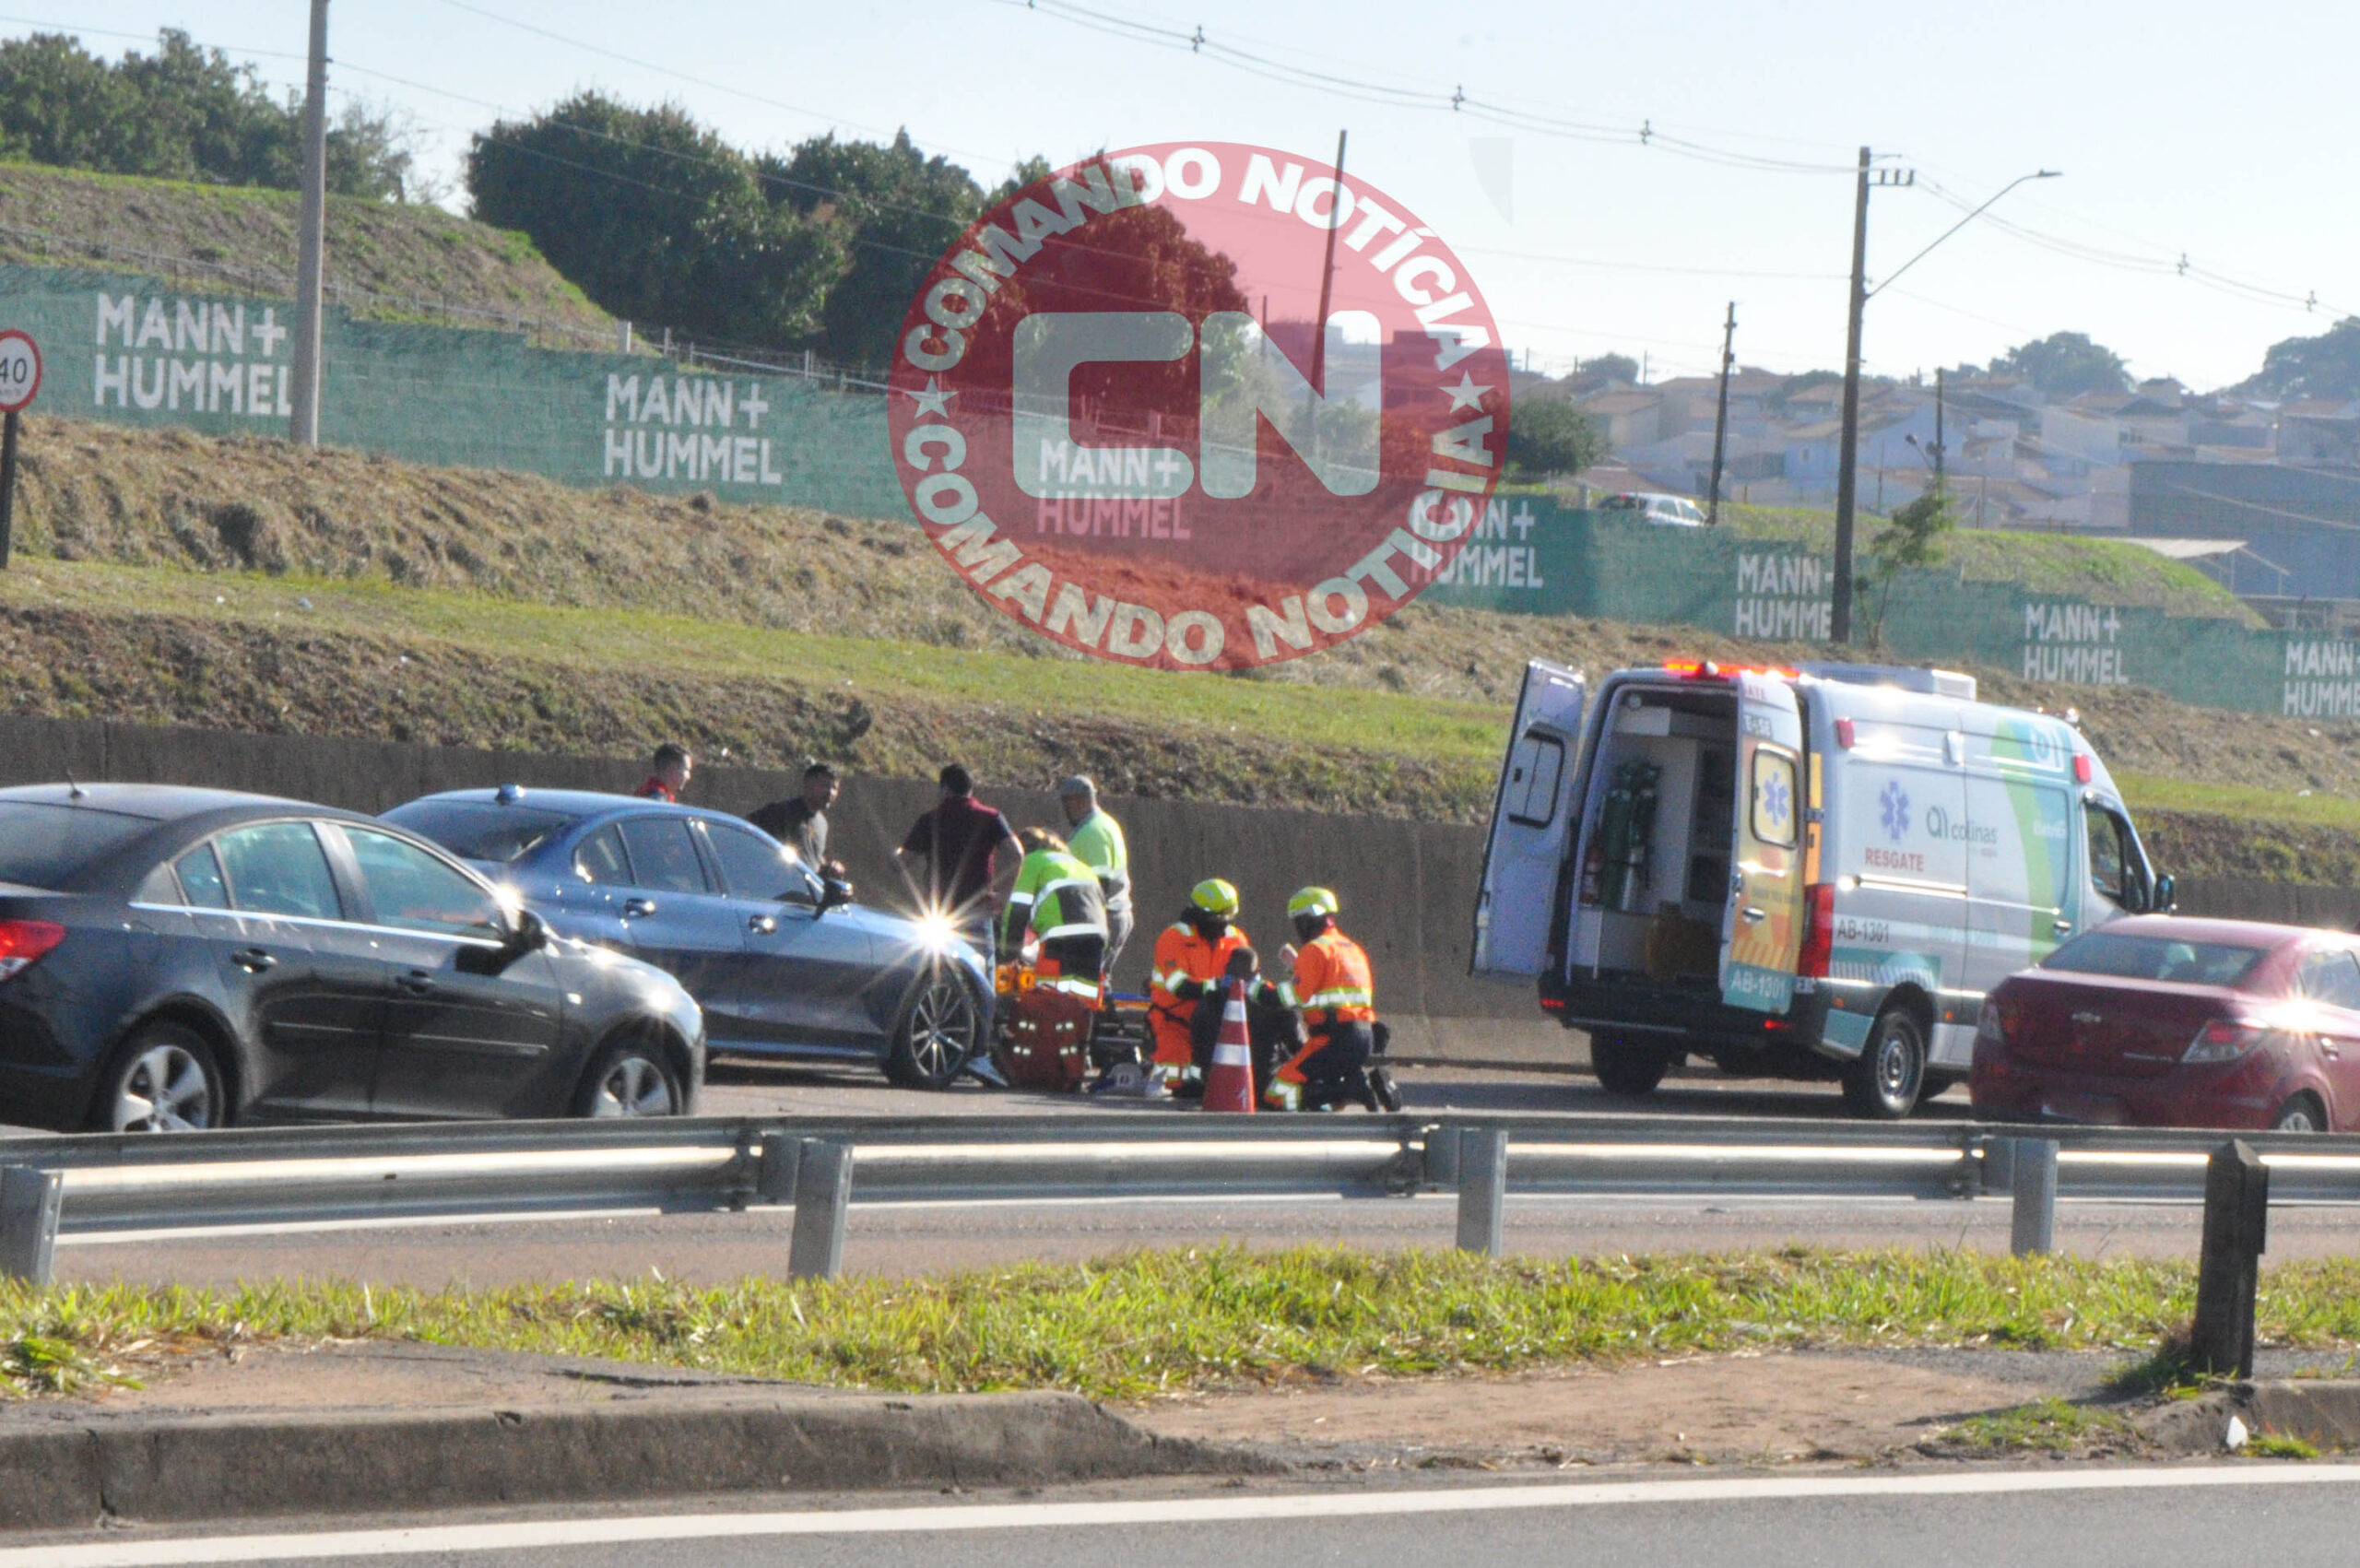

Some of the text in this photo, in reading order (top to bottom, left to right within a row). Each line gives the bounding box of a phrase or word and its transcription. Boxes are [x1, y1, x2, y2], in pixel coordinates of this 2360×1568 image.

[94, 354, 293, 417] HUMMEL
[604, 429, 783, 485] HUMMEL
[1037, 489, 1191, 539] HUMMEL
[1735, 598, 1833, 639] HUMME
[2024, 645, 2129, 684] HUMMEL
[2284, 641, 2360, 676] MANN
[1864, 847, 1925, 872] RESGATE
[1836, 918, 1890, 943] AB-1301
[1730, 968, 1786, 999] AB-1301
